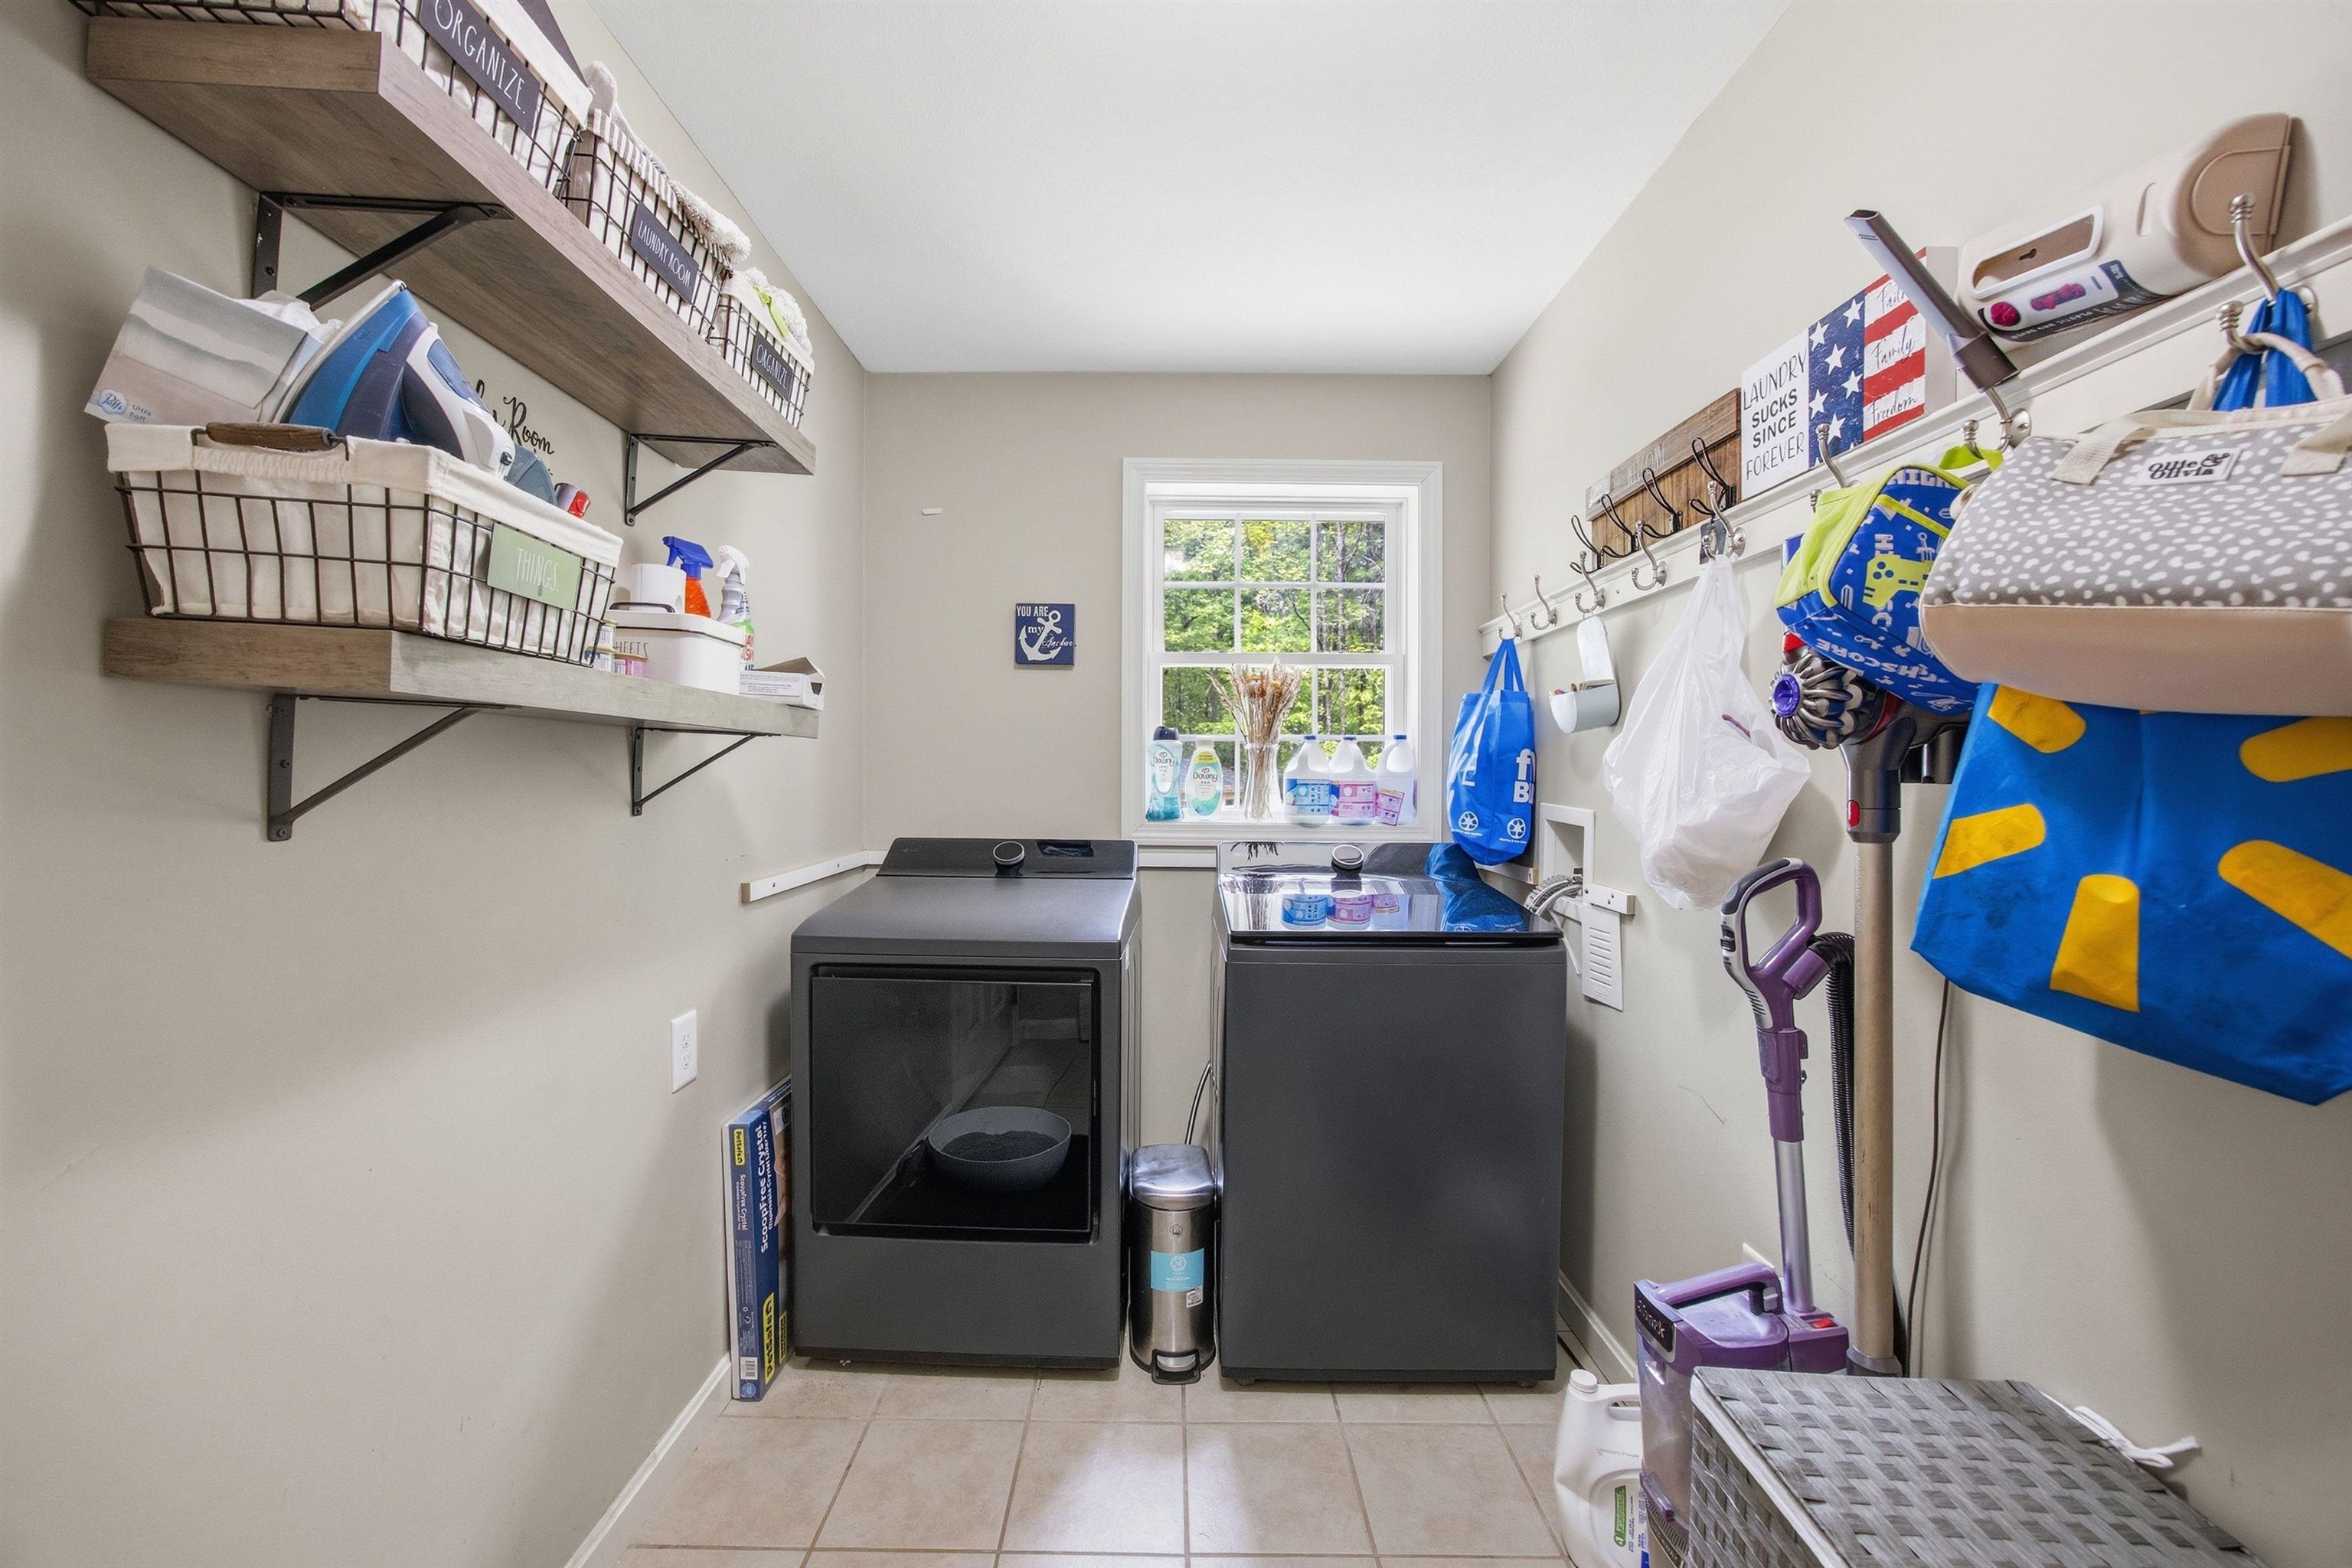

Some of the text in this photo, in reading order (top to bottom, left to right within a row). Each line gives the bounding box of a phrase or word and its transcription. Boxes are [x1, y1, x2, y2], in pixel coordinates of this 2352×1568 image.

[638, 220, 668, 263] LAUNDRY
[1743, 348, 1808, 411] LAUNDRY
[101, 392, 122, 410] Puffs
[1751, 387, 1798, 429] SUCKS
[1867, 389, 1919, 426] Freedom
[502, 396, 555, 456] Room
[1752, 410, 1797, 449] SINCE
[1746, 431, 1805, 481] FOREVER
[2148, 459, 2198, 472] Ollie
[1016, 605, 1049, 617] YOU ARE
[1027, 626, 1044, 636] my
[1193, 772, 1218, 782] Downy
[754, 1124, 769, 1253] ScoopFree Crystal
